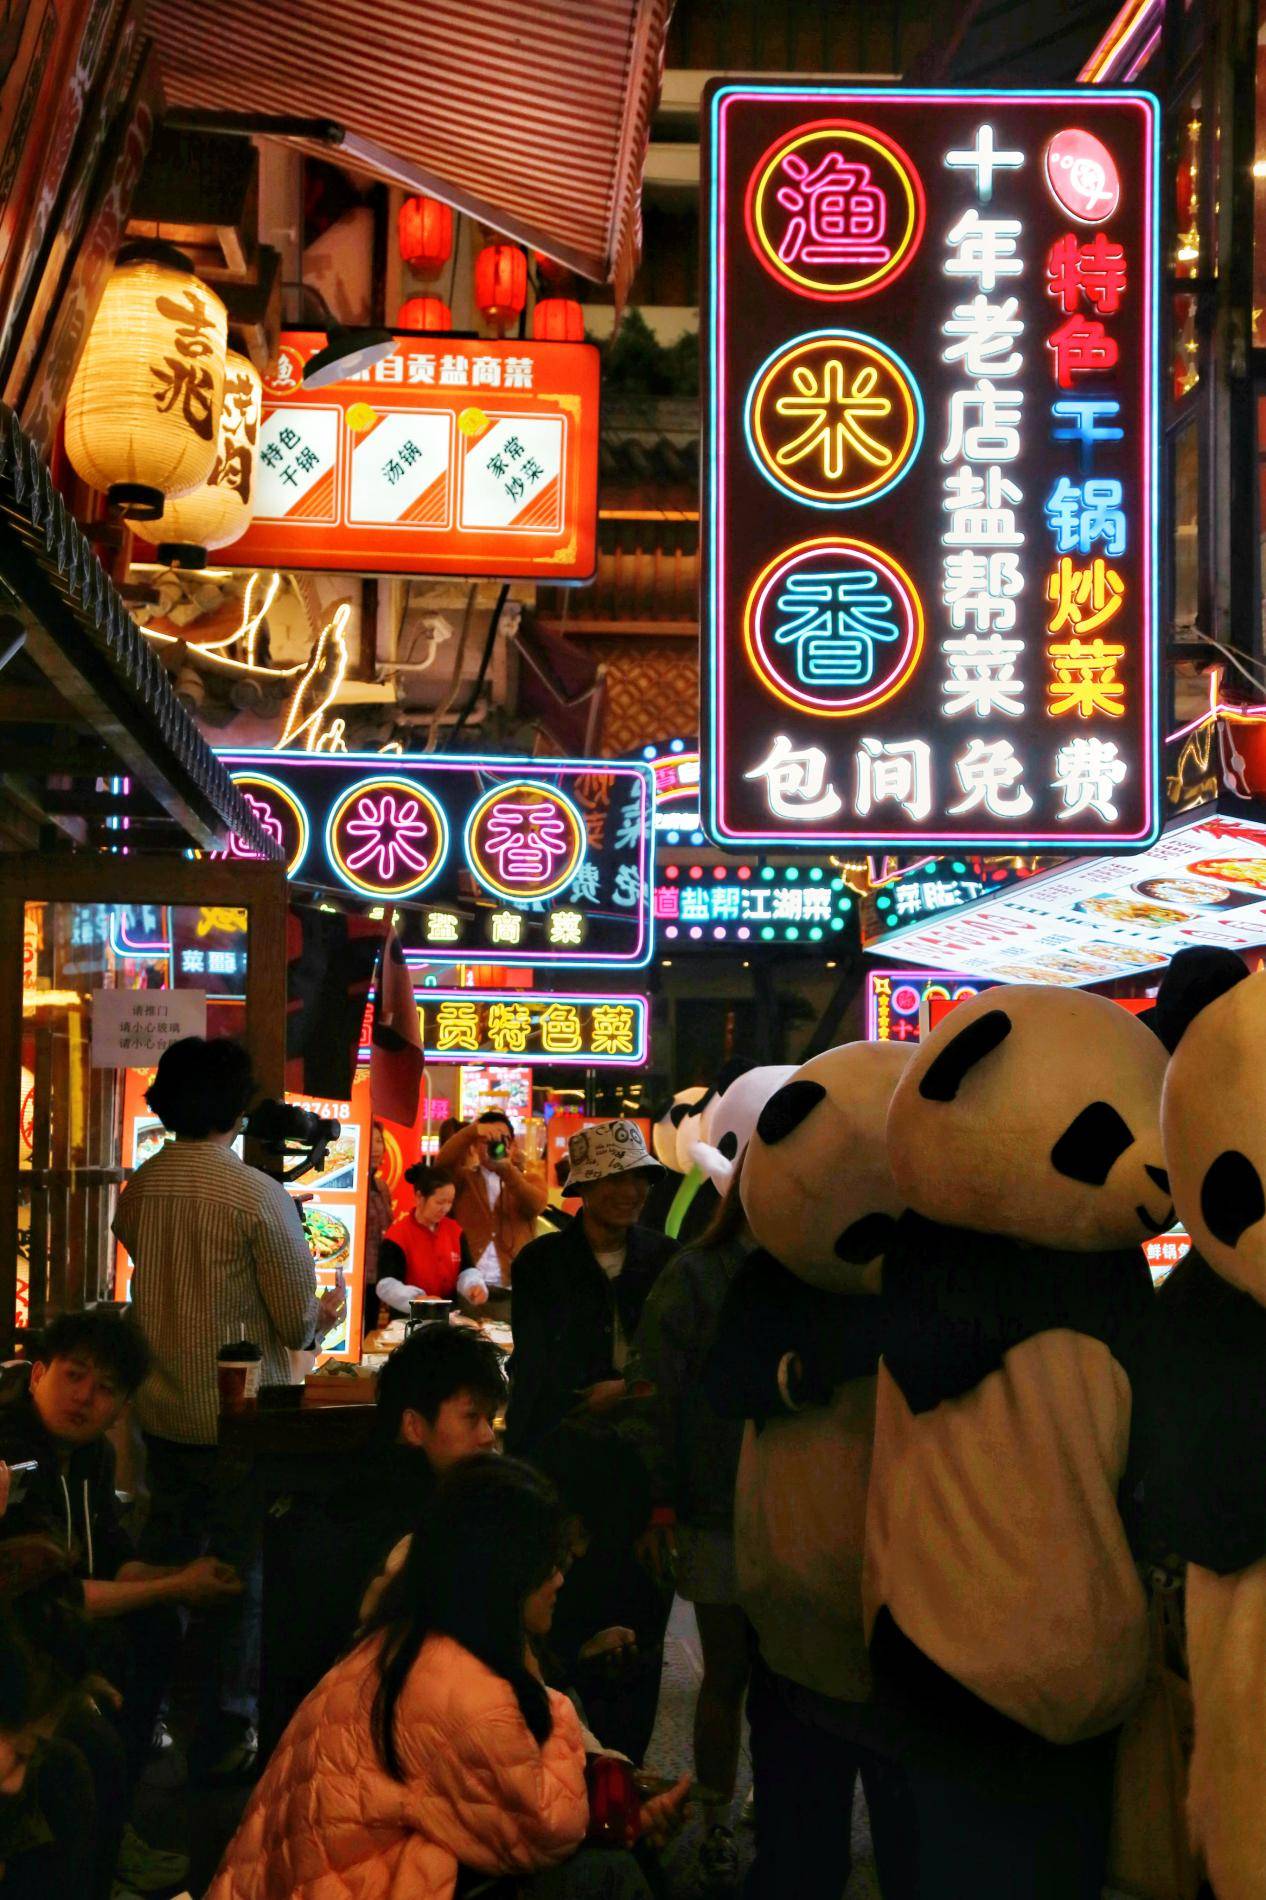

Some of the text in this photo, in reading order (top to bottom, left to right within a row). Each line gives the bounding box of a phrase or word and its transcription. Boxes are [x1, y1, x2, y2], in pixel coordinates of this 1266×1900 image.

[148, 289, 217, 442] 吉兆
[943, 124, 1026, 718] 十年老店盐帮菜
[380, 439, 423, 486] 汤锅
[744, 735, 1128, 822] 包间免费
[416, 1002, 634, 1054] 贡特色菜
[292, 1102, 350, 1119] 37618
